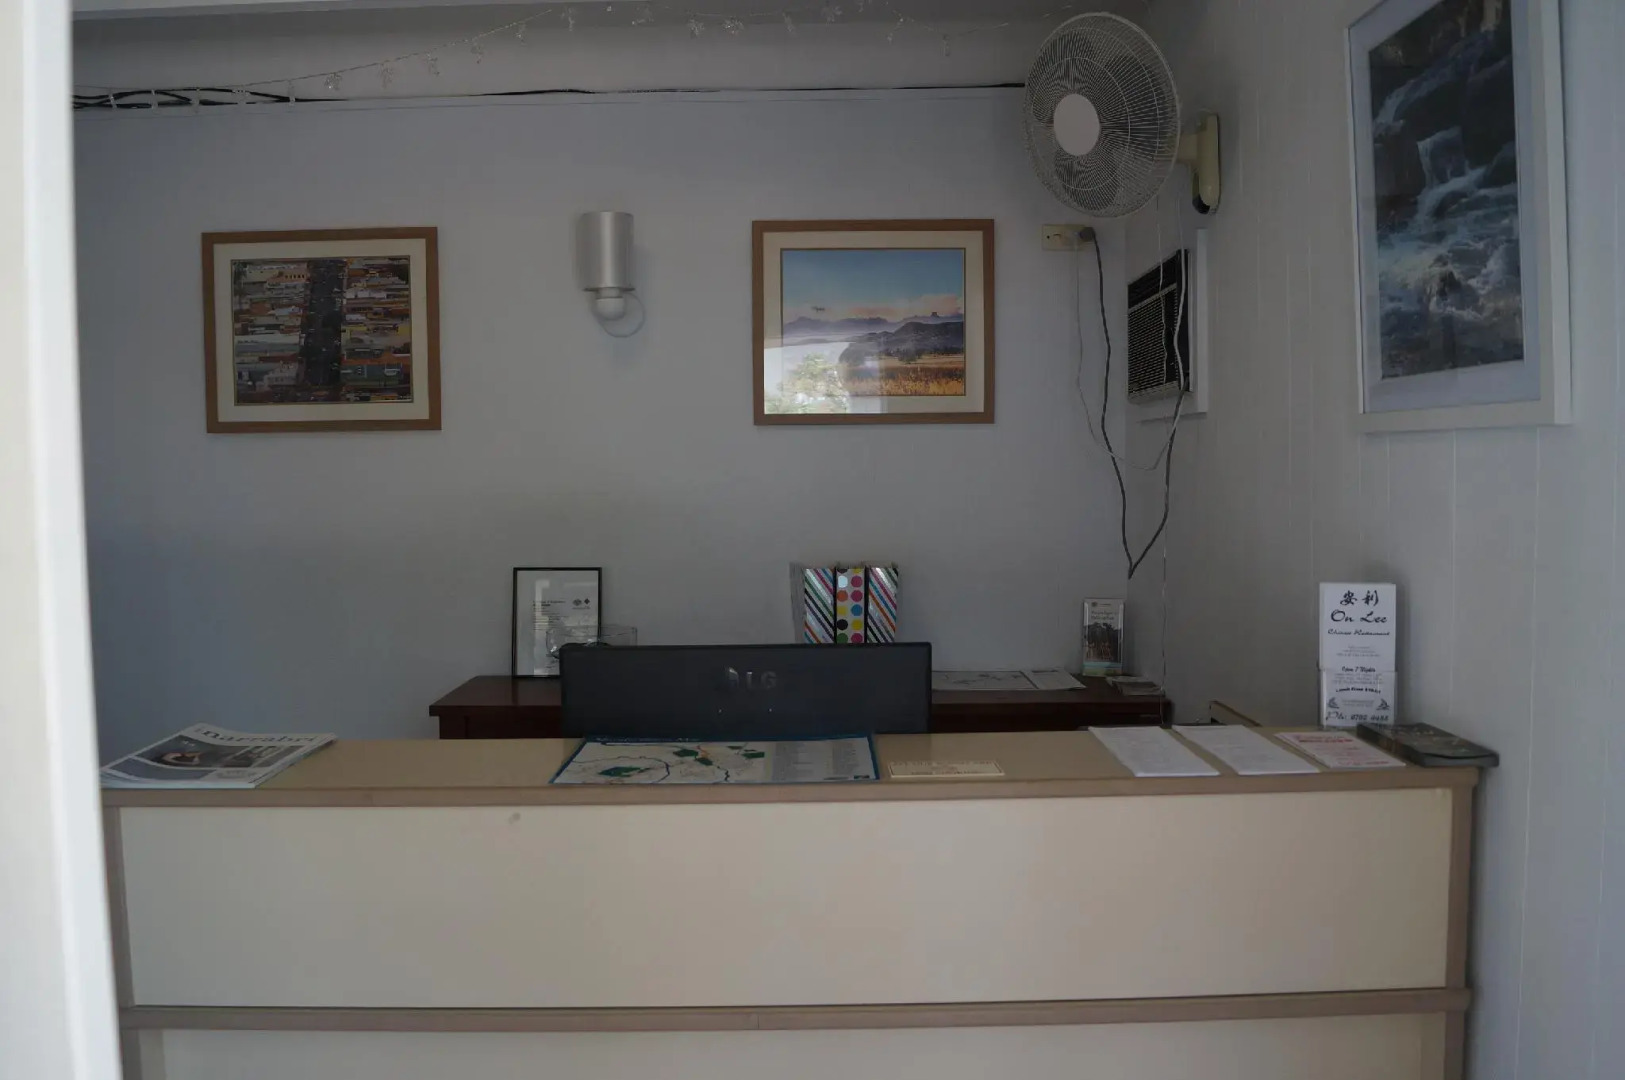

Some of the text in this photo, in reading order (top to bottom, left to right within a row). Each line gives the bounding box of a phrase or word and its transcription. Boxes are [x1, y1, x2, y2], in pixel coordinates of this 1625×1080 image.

[1331, 609, 1387, 623] On Lee
[744, 670, 777, 688] LG
